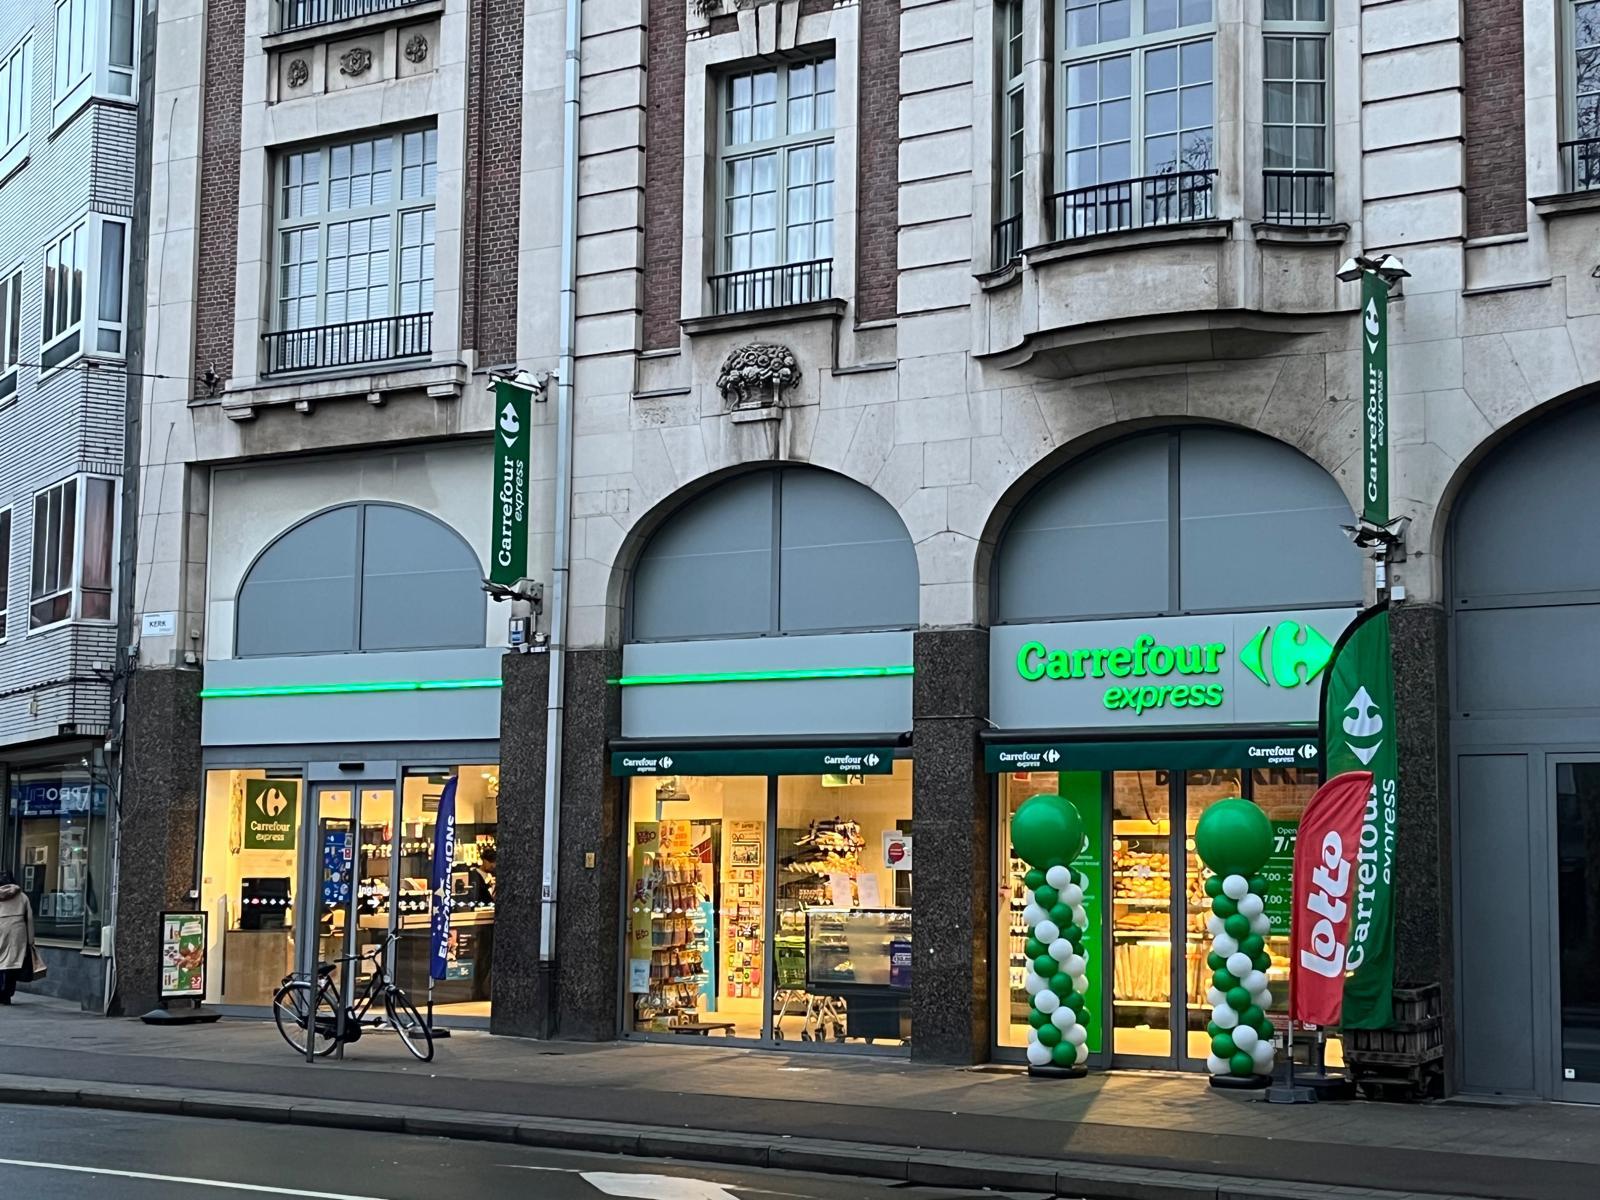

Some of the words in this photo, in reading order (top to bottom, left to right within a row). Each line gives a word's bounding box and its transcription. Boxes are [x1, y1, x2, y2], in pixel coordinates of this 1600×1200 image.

[1367, 363, 1378, 502] Carrefour
[515, 460, 525, 522] express
[499, 456, 514, 567] Carrefour
[1016, 634, 1226, 681] Carrefour
[1103, 683, 1224, 715] express
[999, 751, 1041, 761] Carrefour
[1248, 745, 1296, 757] Carrefour
[623, 757, 657, 767] Carrefour
[824, 755, 862, 765] Carrefour
[250, 821, 291, 832] Carrefour
[1277, 827, 1297, 835] Open
[256, 833, 285, 842] express
[1301, 830, 1352, 978] Lotto
